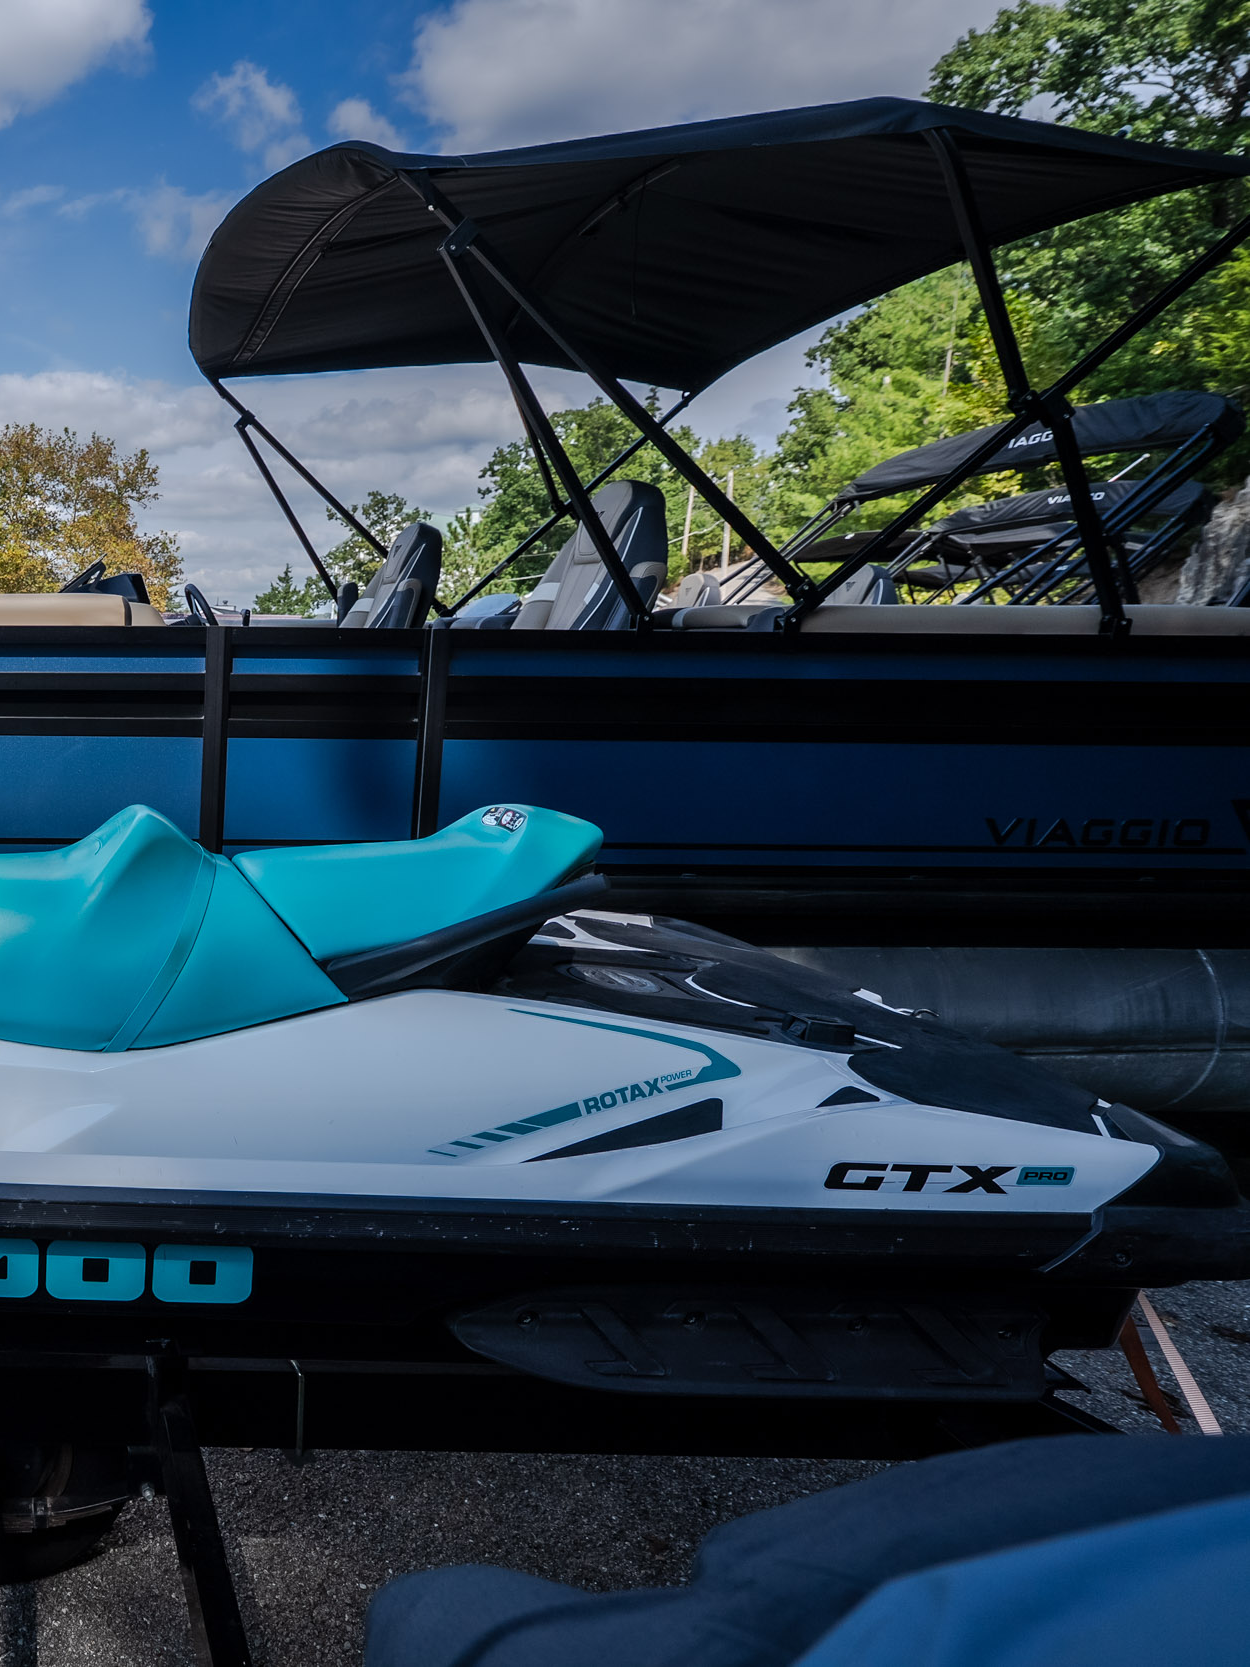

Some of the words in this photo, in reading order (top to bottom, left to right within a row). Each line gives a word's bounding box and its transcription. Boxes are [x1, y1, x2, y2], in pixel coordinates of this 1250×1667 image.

[1008, 431, 1053, 449] IAGG
[1047, 491, 1105, 504] VIAO
[985, 817, 1211, 846] VIAGGIO
[582, 1077, 664, 1115] ROTAX
[660, 1069, 693, 1084] POWER
[824, 1162, 1017, 1195] GTX
[1023, 1171, 1069, 1182] PRO
